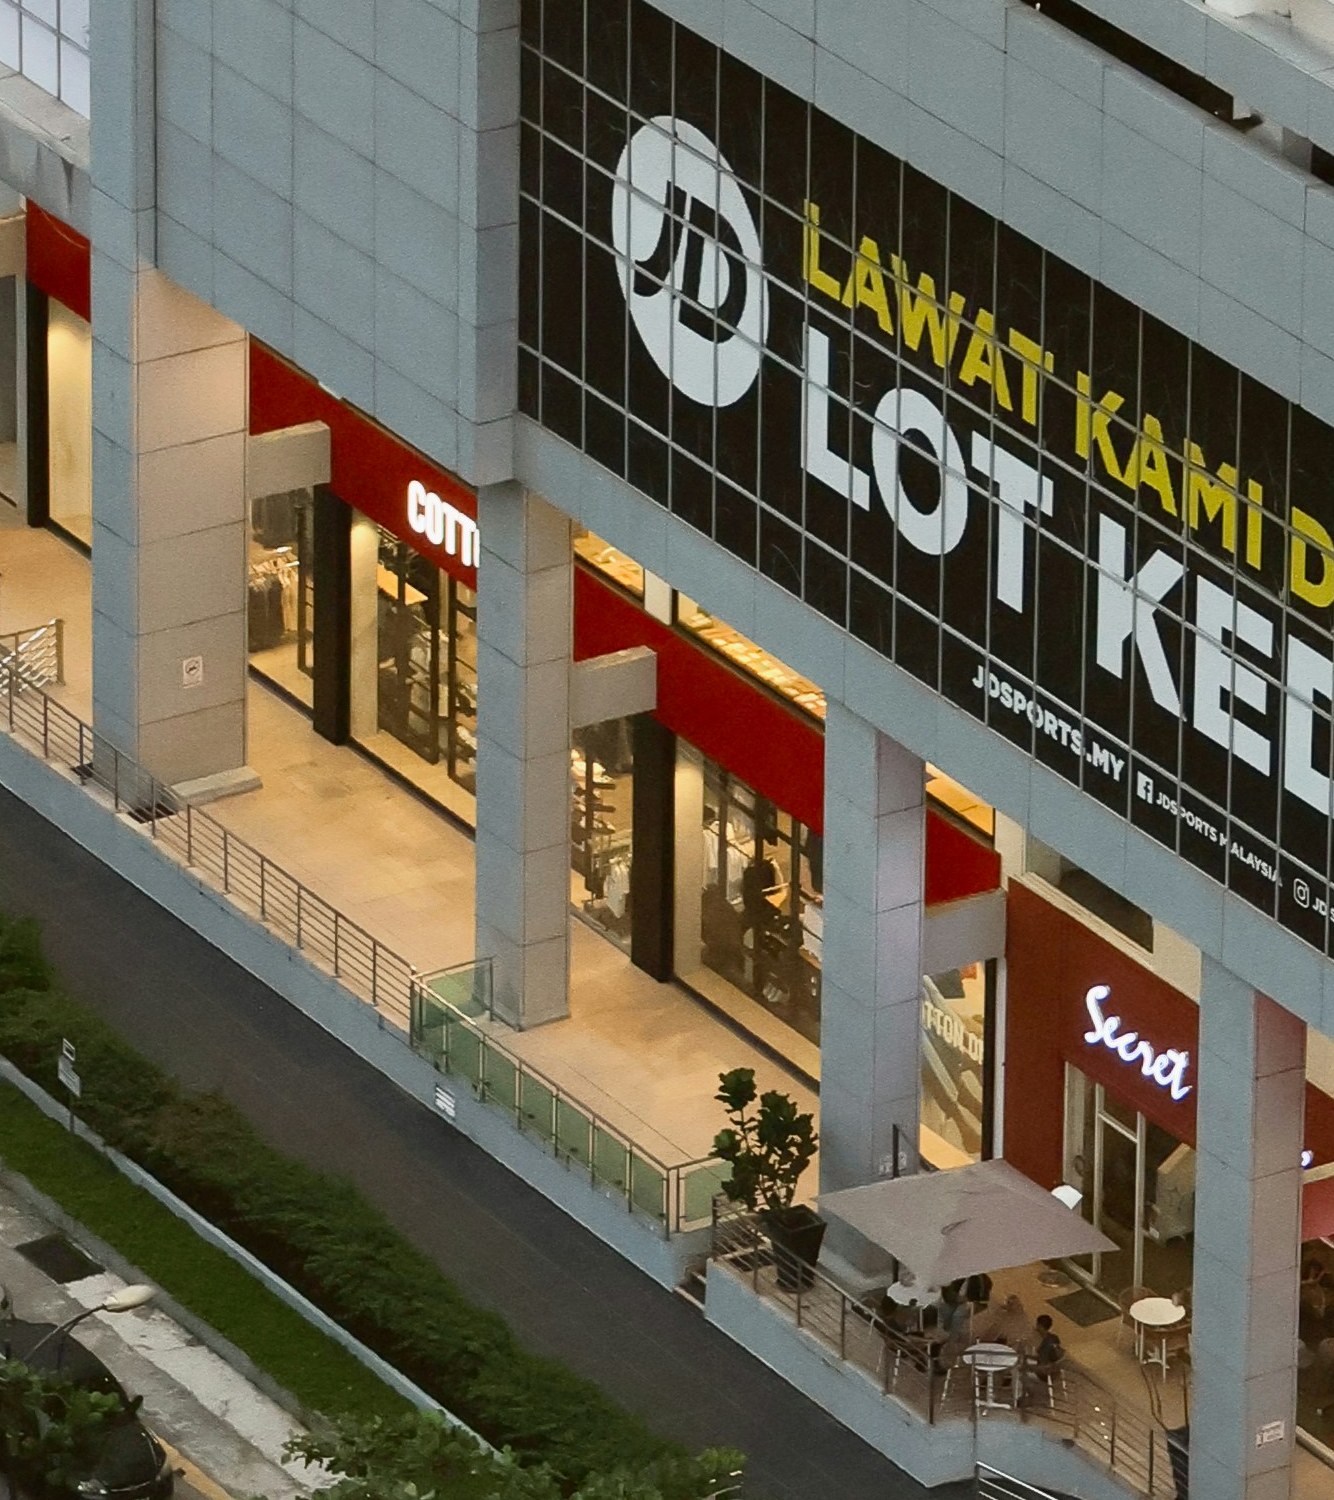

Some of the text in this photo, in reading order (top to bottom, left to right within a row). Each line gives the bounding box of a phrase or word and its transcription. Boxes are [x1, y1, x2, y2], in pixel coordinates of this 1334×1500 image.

[633, 178, 748, 345] JD
[800, 319, 1054, 615] LOT
[802, 198, 1055, 427] LAWAT
[1074, 370, 1264, 573] KAMI
[971, 664, 1125, 783] JDSPORTS.MY
[1084, 984, 1193, 1100] Secret
